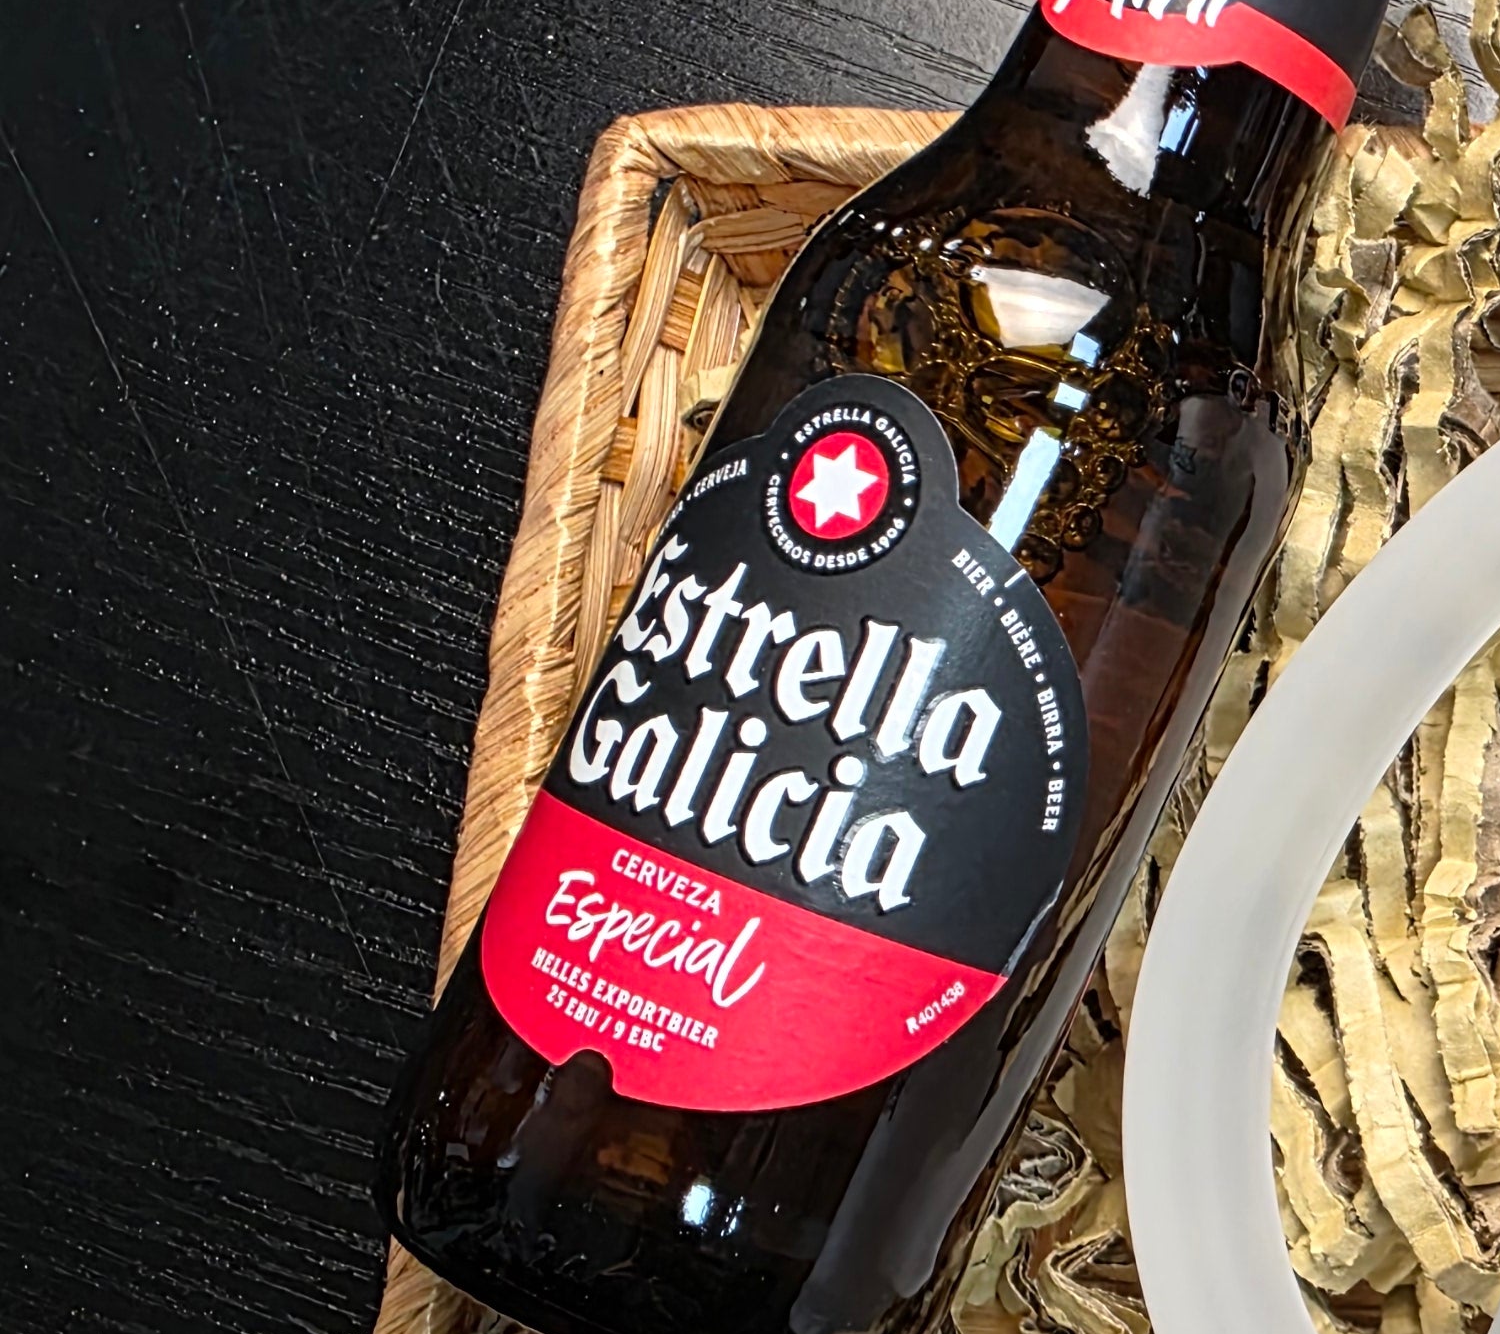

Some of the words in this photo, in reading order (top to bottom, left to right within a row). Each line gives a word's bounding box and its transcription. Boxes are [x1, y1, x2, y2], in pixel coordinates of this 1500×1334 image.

[693, 458, 747, 497] CERVEJA
[794, 408, 871, 443] ESTRELLA
[875, 417, 917, 484] GALICIA
[766, 474, 811, 564] CERVECEROS
[814, 548, 869, 569] DESDE
[870, 517, 905, 554] 1906
[952, 548, 996, 596] BIER
[614, 533, 1002, 787] Estrella
[1000, 608, 1042, 669] BIÈRE
[1037, 686, 1064, 755] BIRRA
[570, 659, 927, 912] Galicia
[1042, 779, 1064, 833] BEER
[611, 848, 721, 915] CERVEZA
[546, 870, 765, 1008] Especial
[531, 947, 593, 992] HELLES
[591, 979, 719, 1049] EXPORTBIER
[546, 984, 568, 1008] 25
[564, 998, 600, 1028] EBU
[612, 1020, 626, 1040] 9
[627, 1025, 666, 1053] EBC
[905, 981, 965, 1034] R401438
